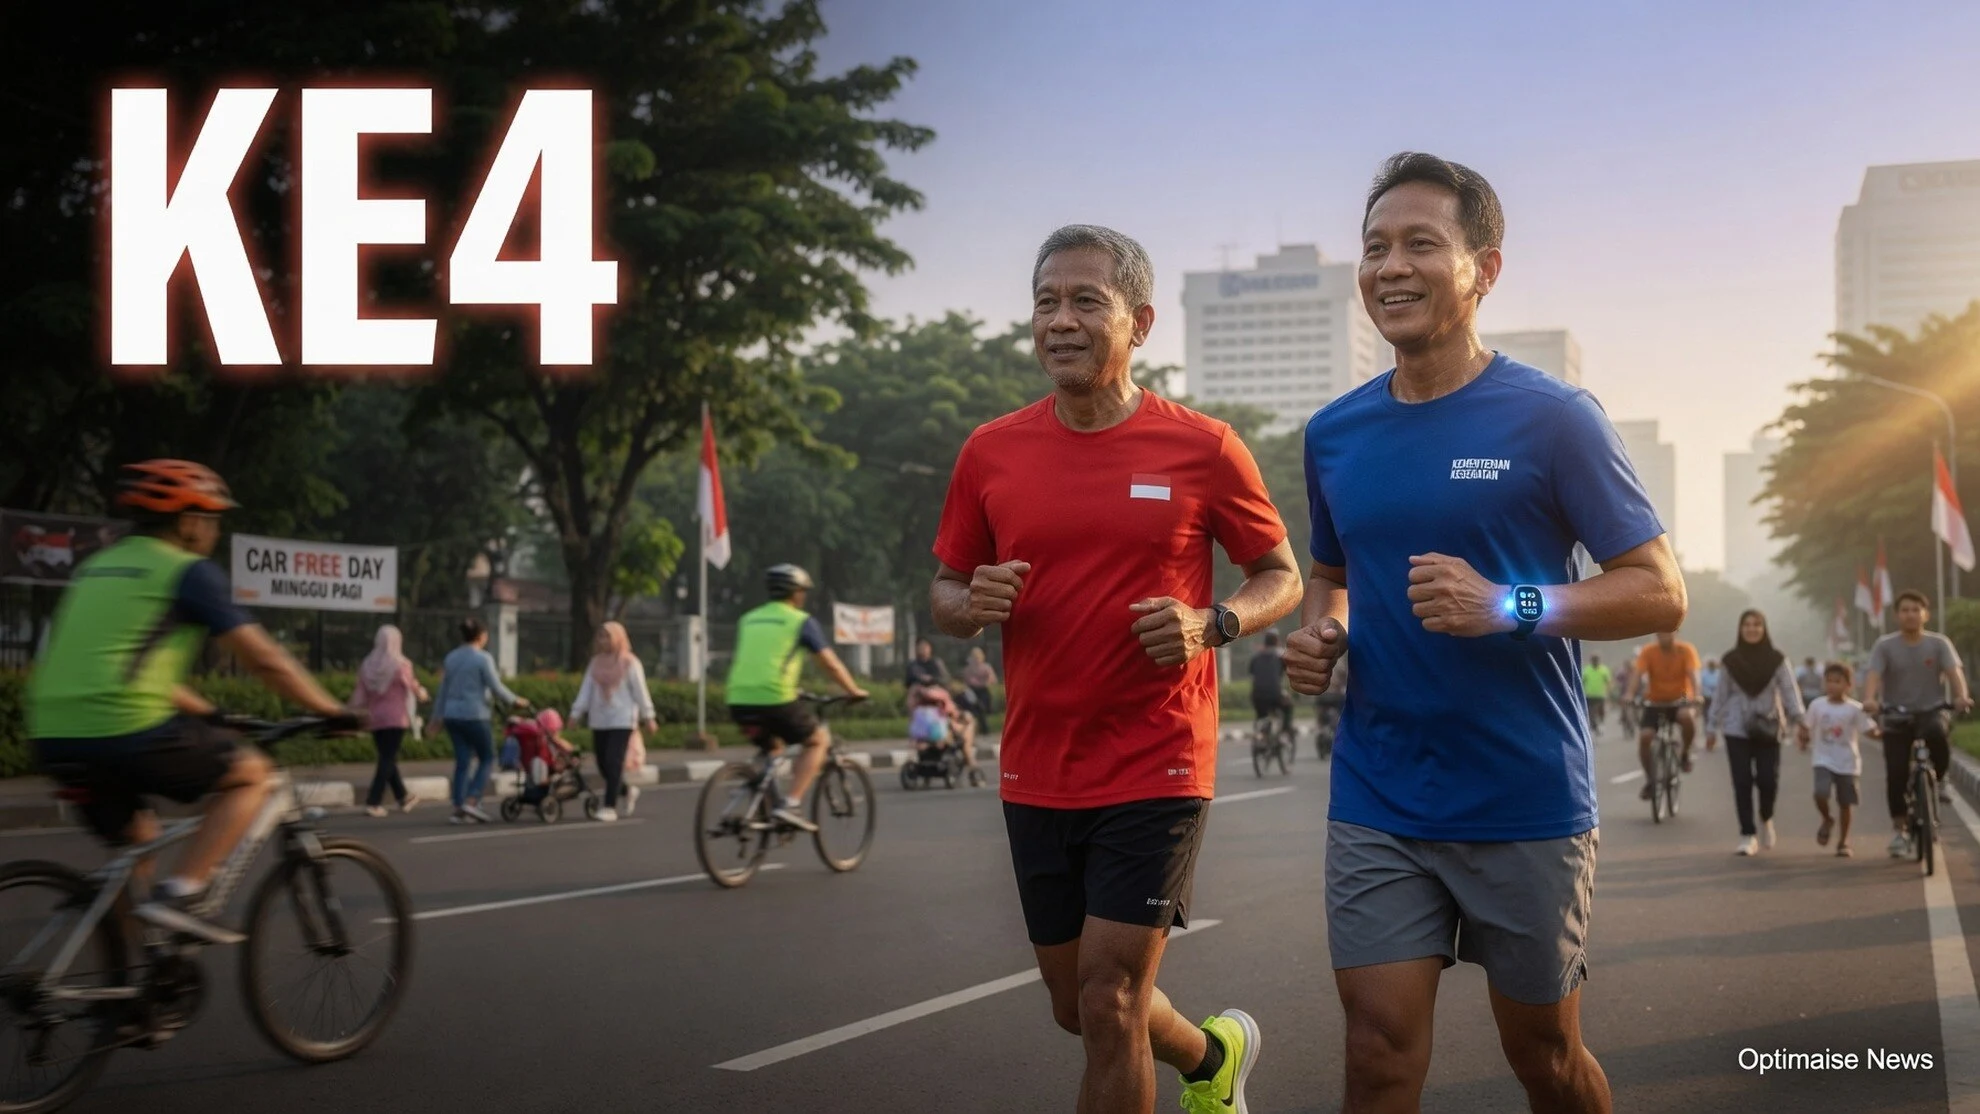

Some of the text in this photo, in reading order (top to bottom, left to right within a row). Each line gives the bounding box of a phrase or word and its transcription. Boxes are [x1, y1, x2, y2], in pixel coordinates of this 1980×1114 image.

[246, 548, 384, 581] CAR FREE DAY
[271, 579, 328, 599] MINGGU
[332, 583, 363, 600] PAGI
